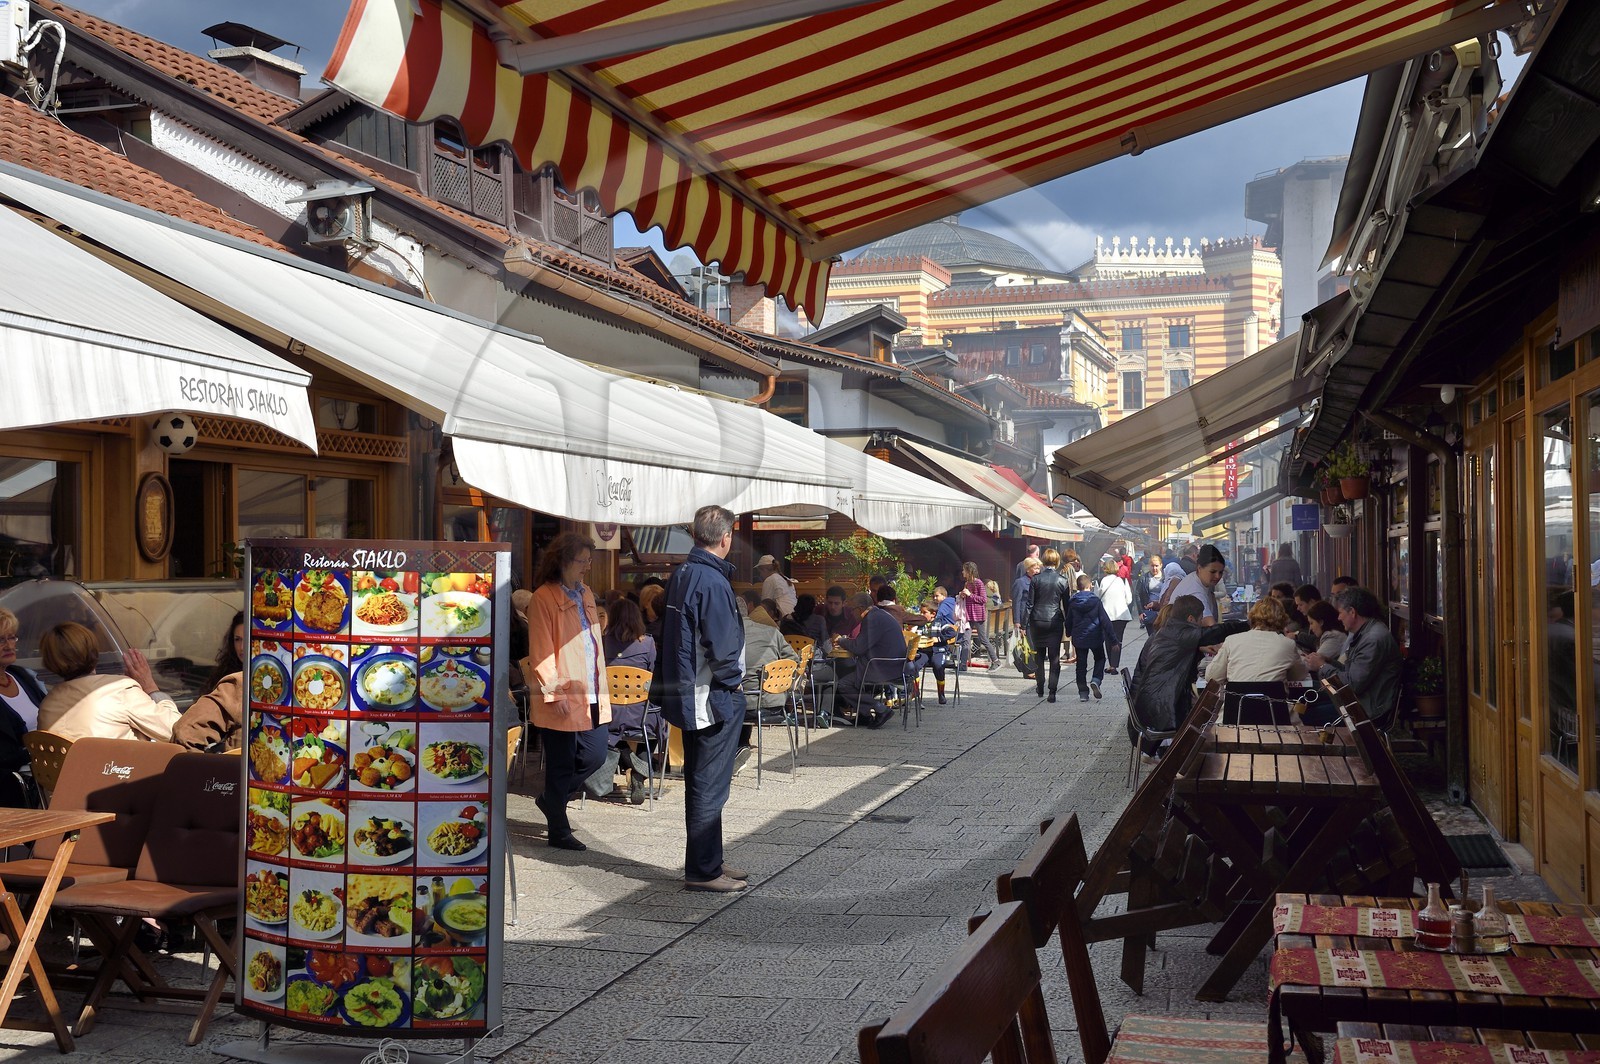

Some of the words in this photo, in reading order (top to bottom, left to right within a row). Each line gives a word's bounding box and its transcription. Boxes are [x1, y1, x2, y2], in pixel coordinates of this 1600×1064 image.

[179, 375, 244, 408] RESTORAN
[247, 388, 288, 416] STAKLO
[303, 552, 349, 568] Restoran
[352, 548, 407, 569] STAKLO
